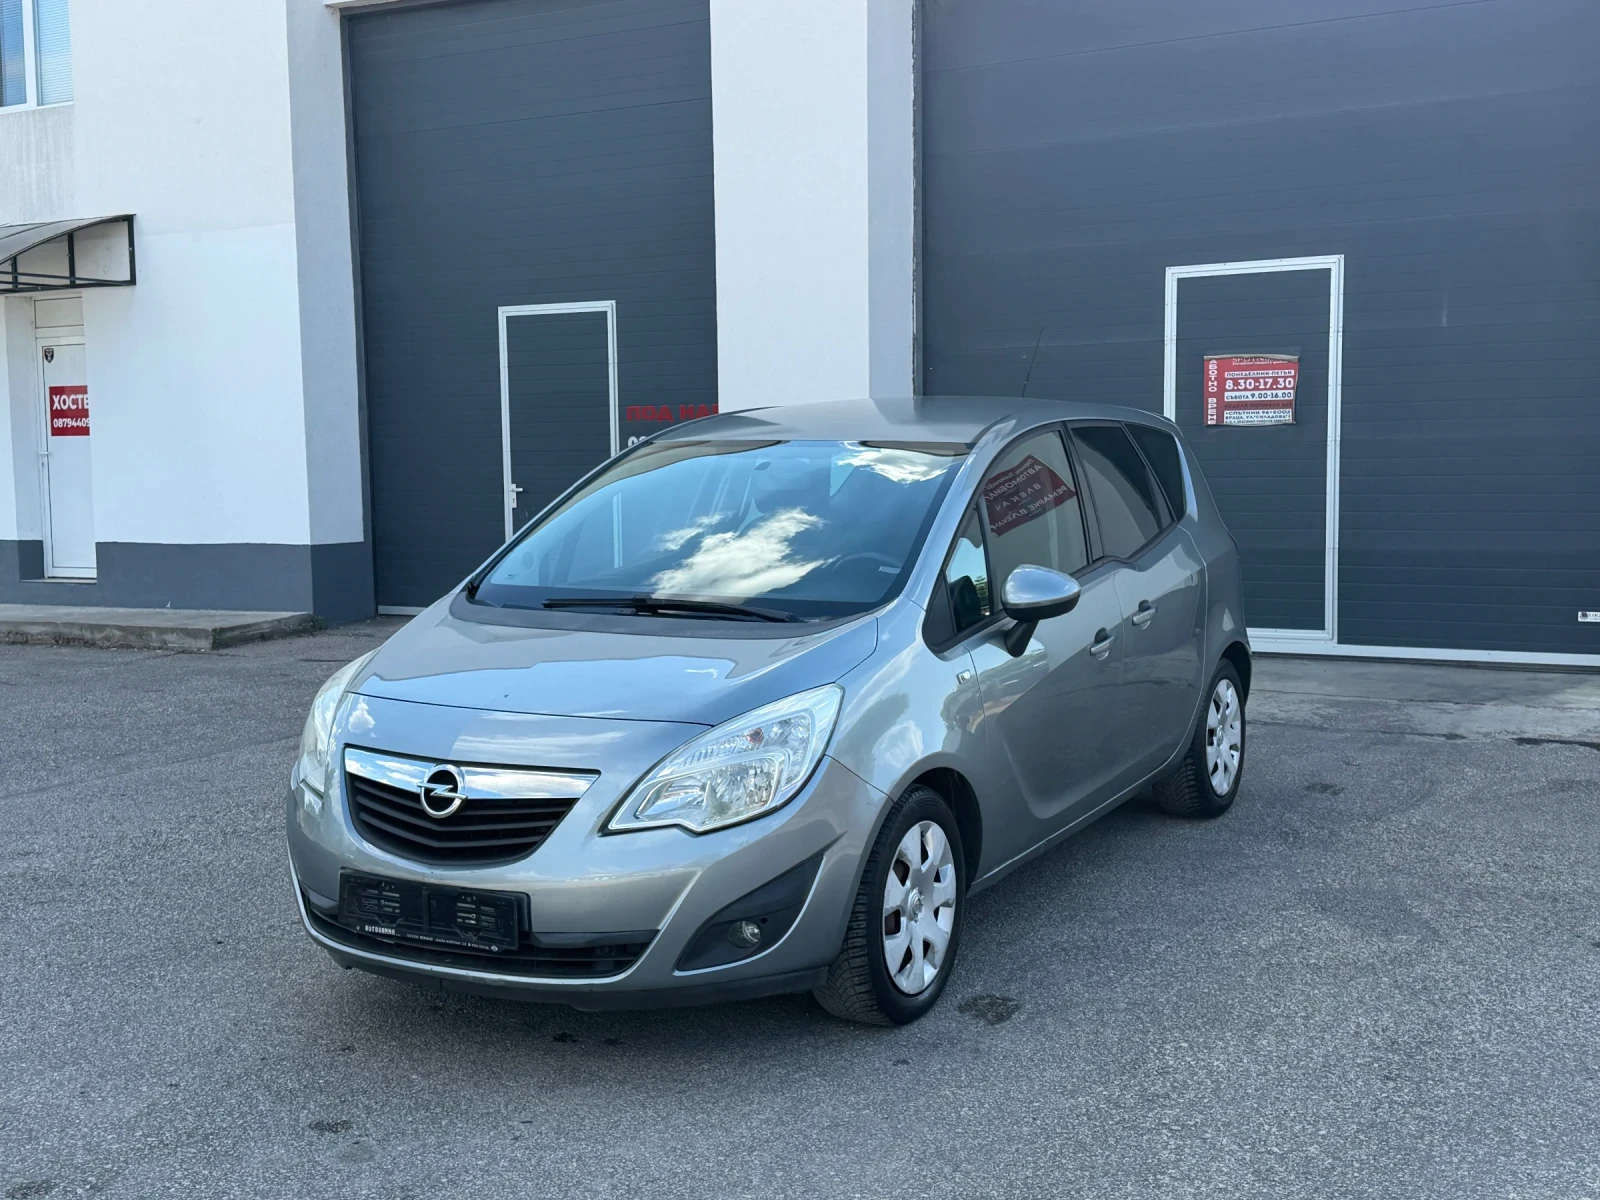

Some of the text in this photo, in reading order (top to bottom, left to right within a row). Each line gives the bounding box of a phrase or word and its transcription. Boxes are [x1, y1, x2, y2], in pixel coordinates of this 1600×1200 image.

[1225, 377, 1294, 390] 8.30-17.30
[1250, 391, 1292, 399] 9.00-16.00
[626, 404, 674, 423] ПОД
[53, 418, 90, 428] 08794409
